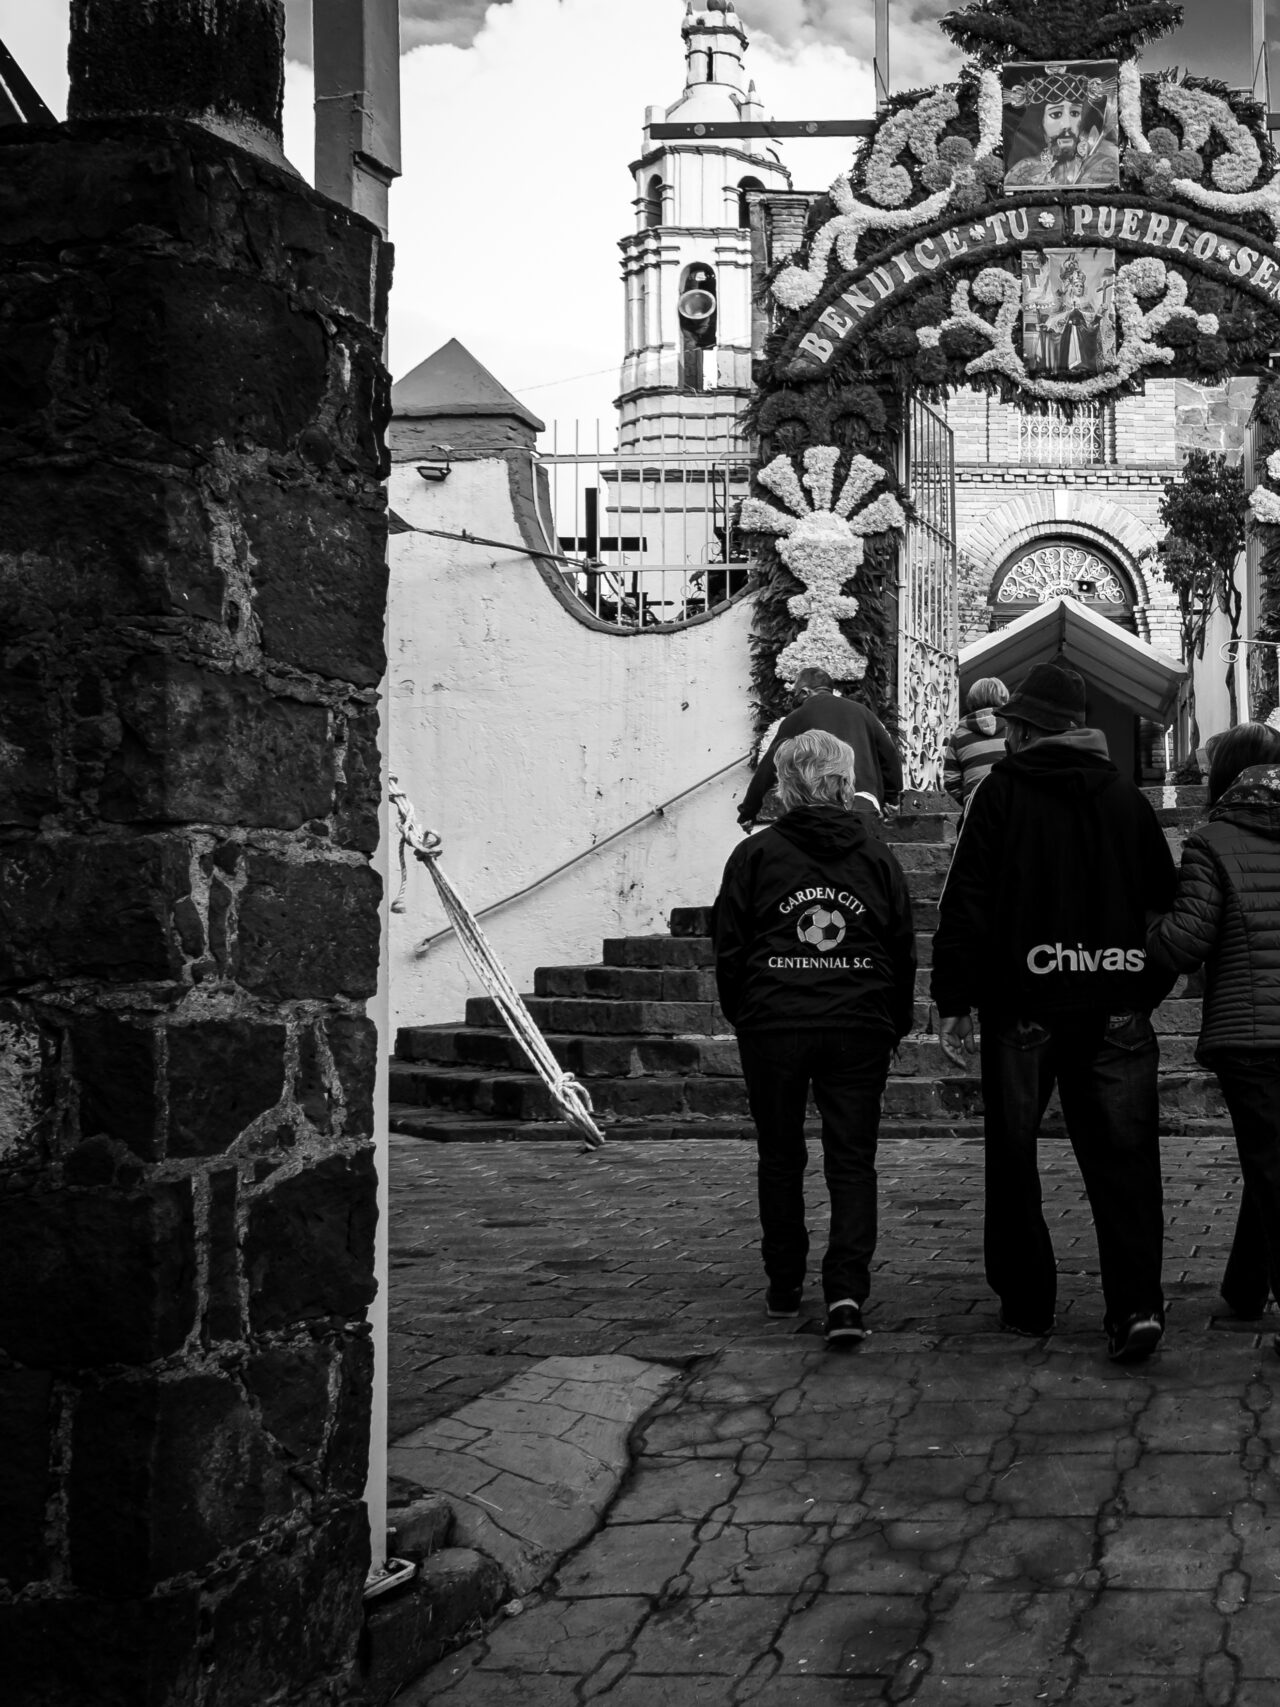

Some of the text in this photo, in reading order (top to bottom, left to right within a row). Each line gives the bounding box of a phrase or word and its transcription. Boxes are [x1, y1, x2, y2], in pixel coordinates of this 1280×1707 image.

[799, 231, 969, 363] BENDICE
[984, 208, 1030, 245] TU
[1071, 204, 1218, 262] PUEBLO
[779, 887, 867, 915] GARDEN CITY
[768, 956, 874, 969] CENTENNIAL S.C.
[1026, 942, 1145, 975] Chivas
